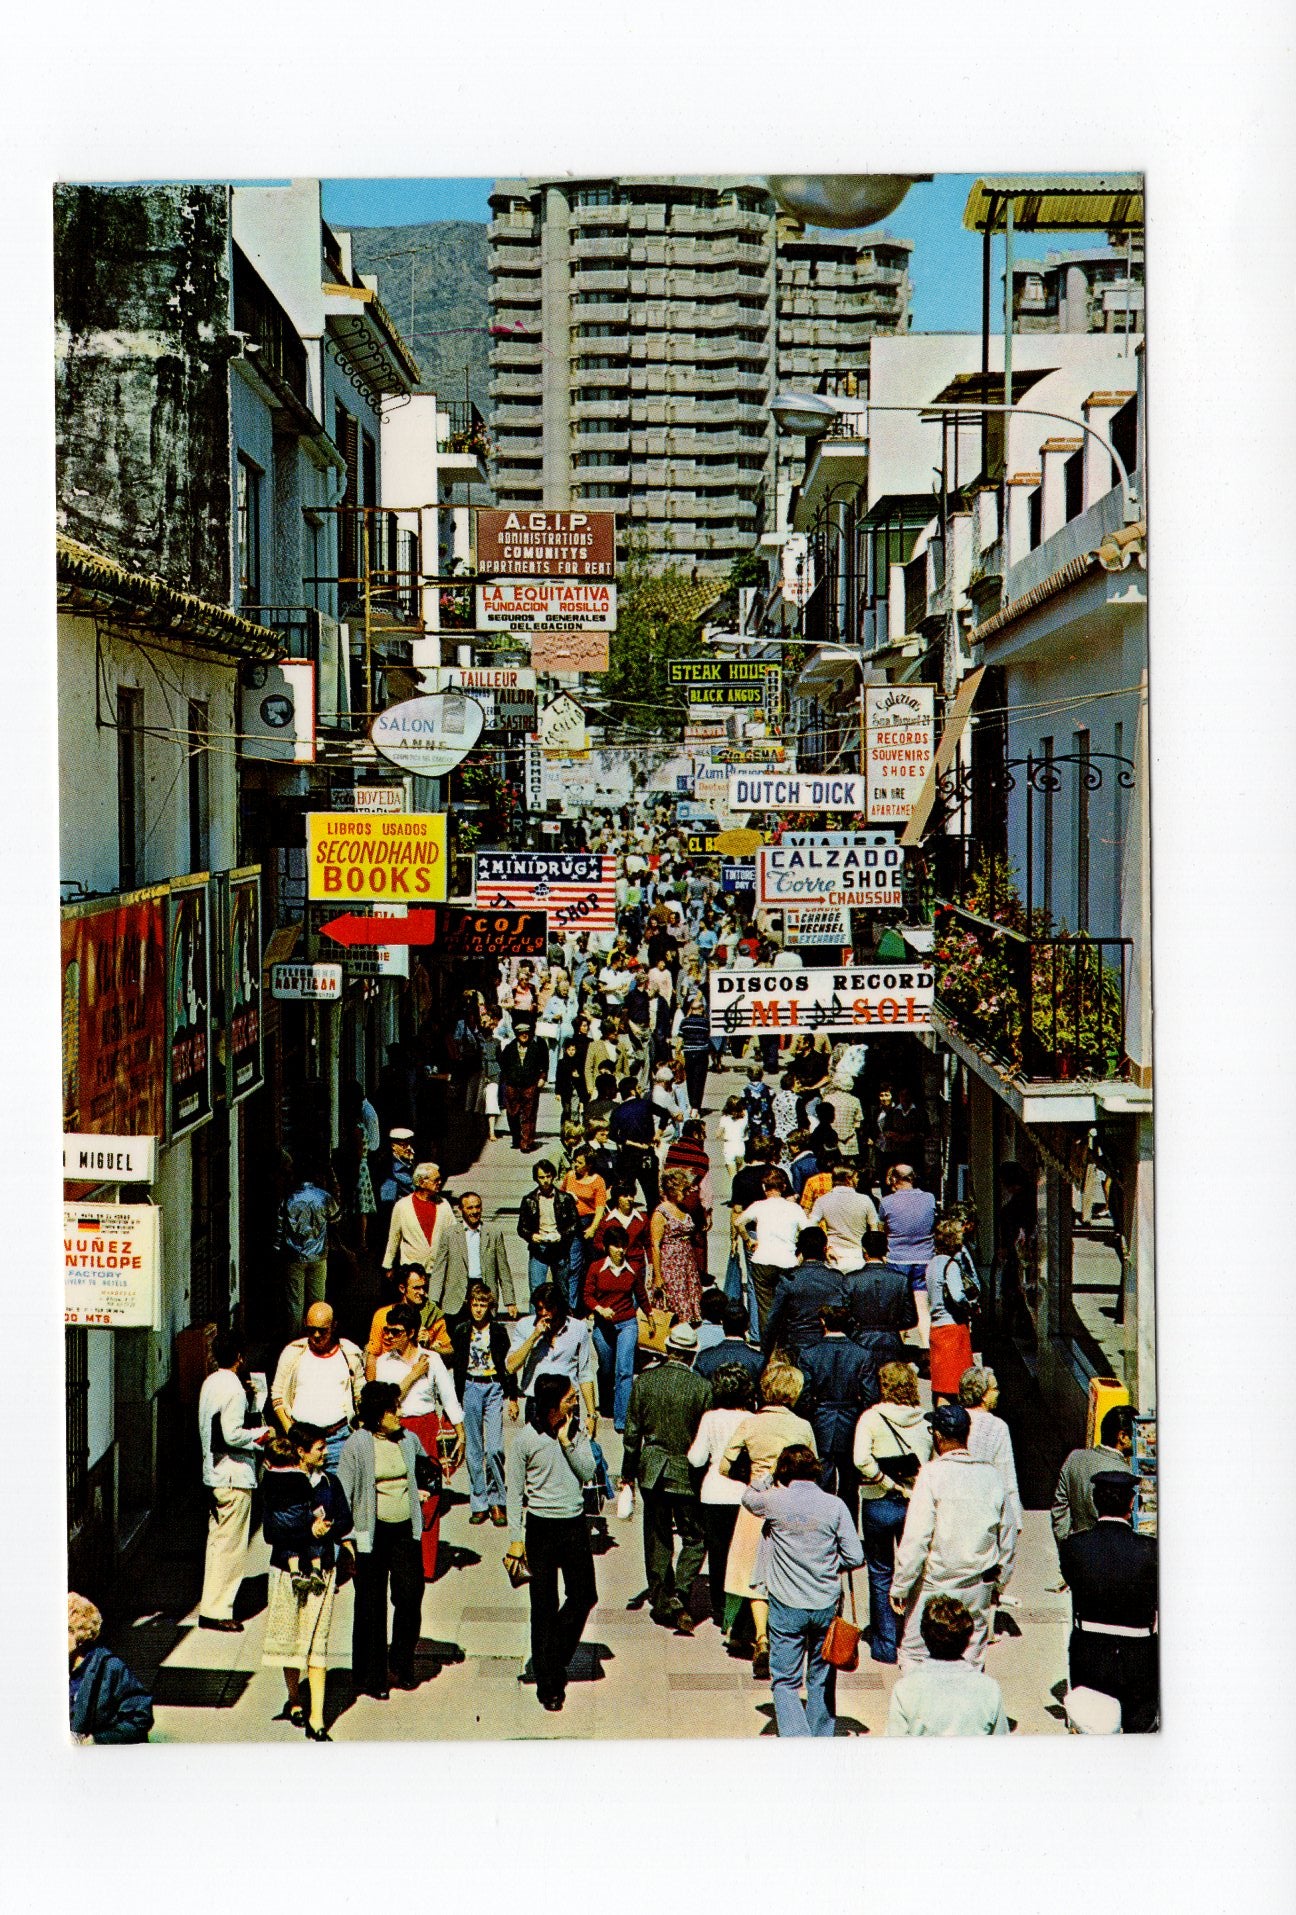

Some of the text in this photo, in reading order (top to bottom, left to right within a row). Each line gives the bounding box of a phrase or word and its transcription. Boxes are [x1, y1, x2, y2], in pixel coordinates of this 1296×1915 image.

[504, 512, 591, 531] A.G.I.P.
[498, 532, 593, 545] ADMINISTRATIONS
[504, 547, 588, 560] COMUNITYS
[479, 560, 611, 575] APARTMENTS FOR RENT
[482, 587, 609, 601] LA EQUITATIVA
[484, 602, 608, 612] FUNDACION ROSILLO
[546, 614, 606, 622] GENERALES
[510, 622, 583, 630] DELEGACION
[460, 671, 517, 687] TAILLEUR
[672, 663, 772, 680] STEAK HOUS
[494, 688, 534, 704] TAILOR
[690, 688, 761, 702] BLACK ANGUS
[379, 716, 434, 733] SALON
[500, 715, 534, 729] SASTRE
[877, 732, 928, 744] RECORDS
[872, 749, 930, 761] SOUVENIRS
[882, 765, 925, 777] SHOES
[737, 781, 855, 804] DUTCH DICK
[328, 822, 427, 836] LIBROS USADOS
[316, 840, 440, 864] SECONDHAND
[689, 837, 717, 852] EL B
[771, 849, 898, 867] CALZADO
[491, 859, 588, 876] MINIDRUG
[323, 866, 431, 893] BOOKS
[766, 870, 835, 892] Torre
[555, 892, 599, 926] SHOP
[801, 912, 841, 923] CHANGE
[717, 973, 934, 993] DISCOS RECORD
[750, 997, 926, 1027] MI SOL
[80, 1151, 133, 1171] MIGUEL
[65, 1254, 142, 1269] NTILOPE
[68, 1269, 122, 1278] FACTORY
[86, 1314, 113, 1324] MTS.
